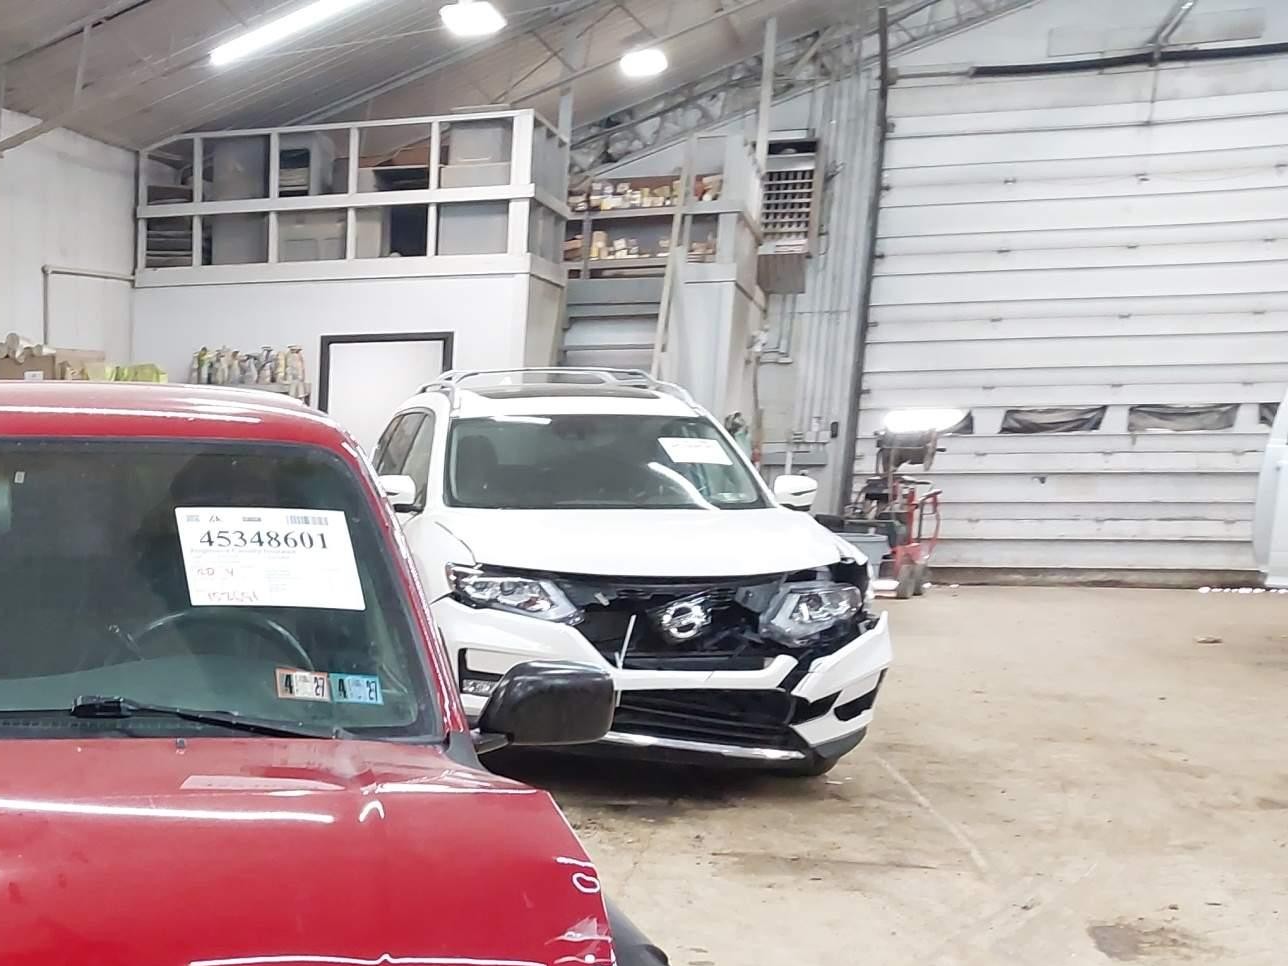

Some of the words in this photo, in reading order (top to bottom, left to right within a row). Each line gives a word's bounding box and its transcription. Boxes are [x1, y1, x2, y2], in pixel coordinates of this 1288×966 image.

[199, 529, 328, 549] 45348601
[284, 674, 293, 694] 4
[338, 678, 347, 698] 4
